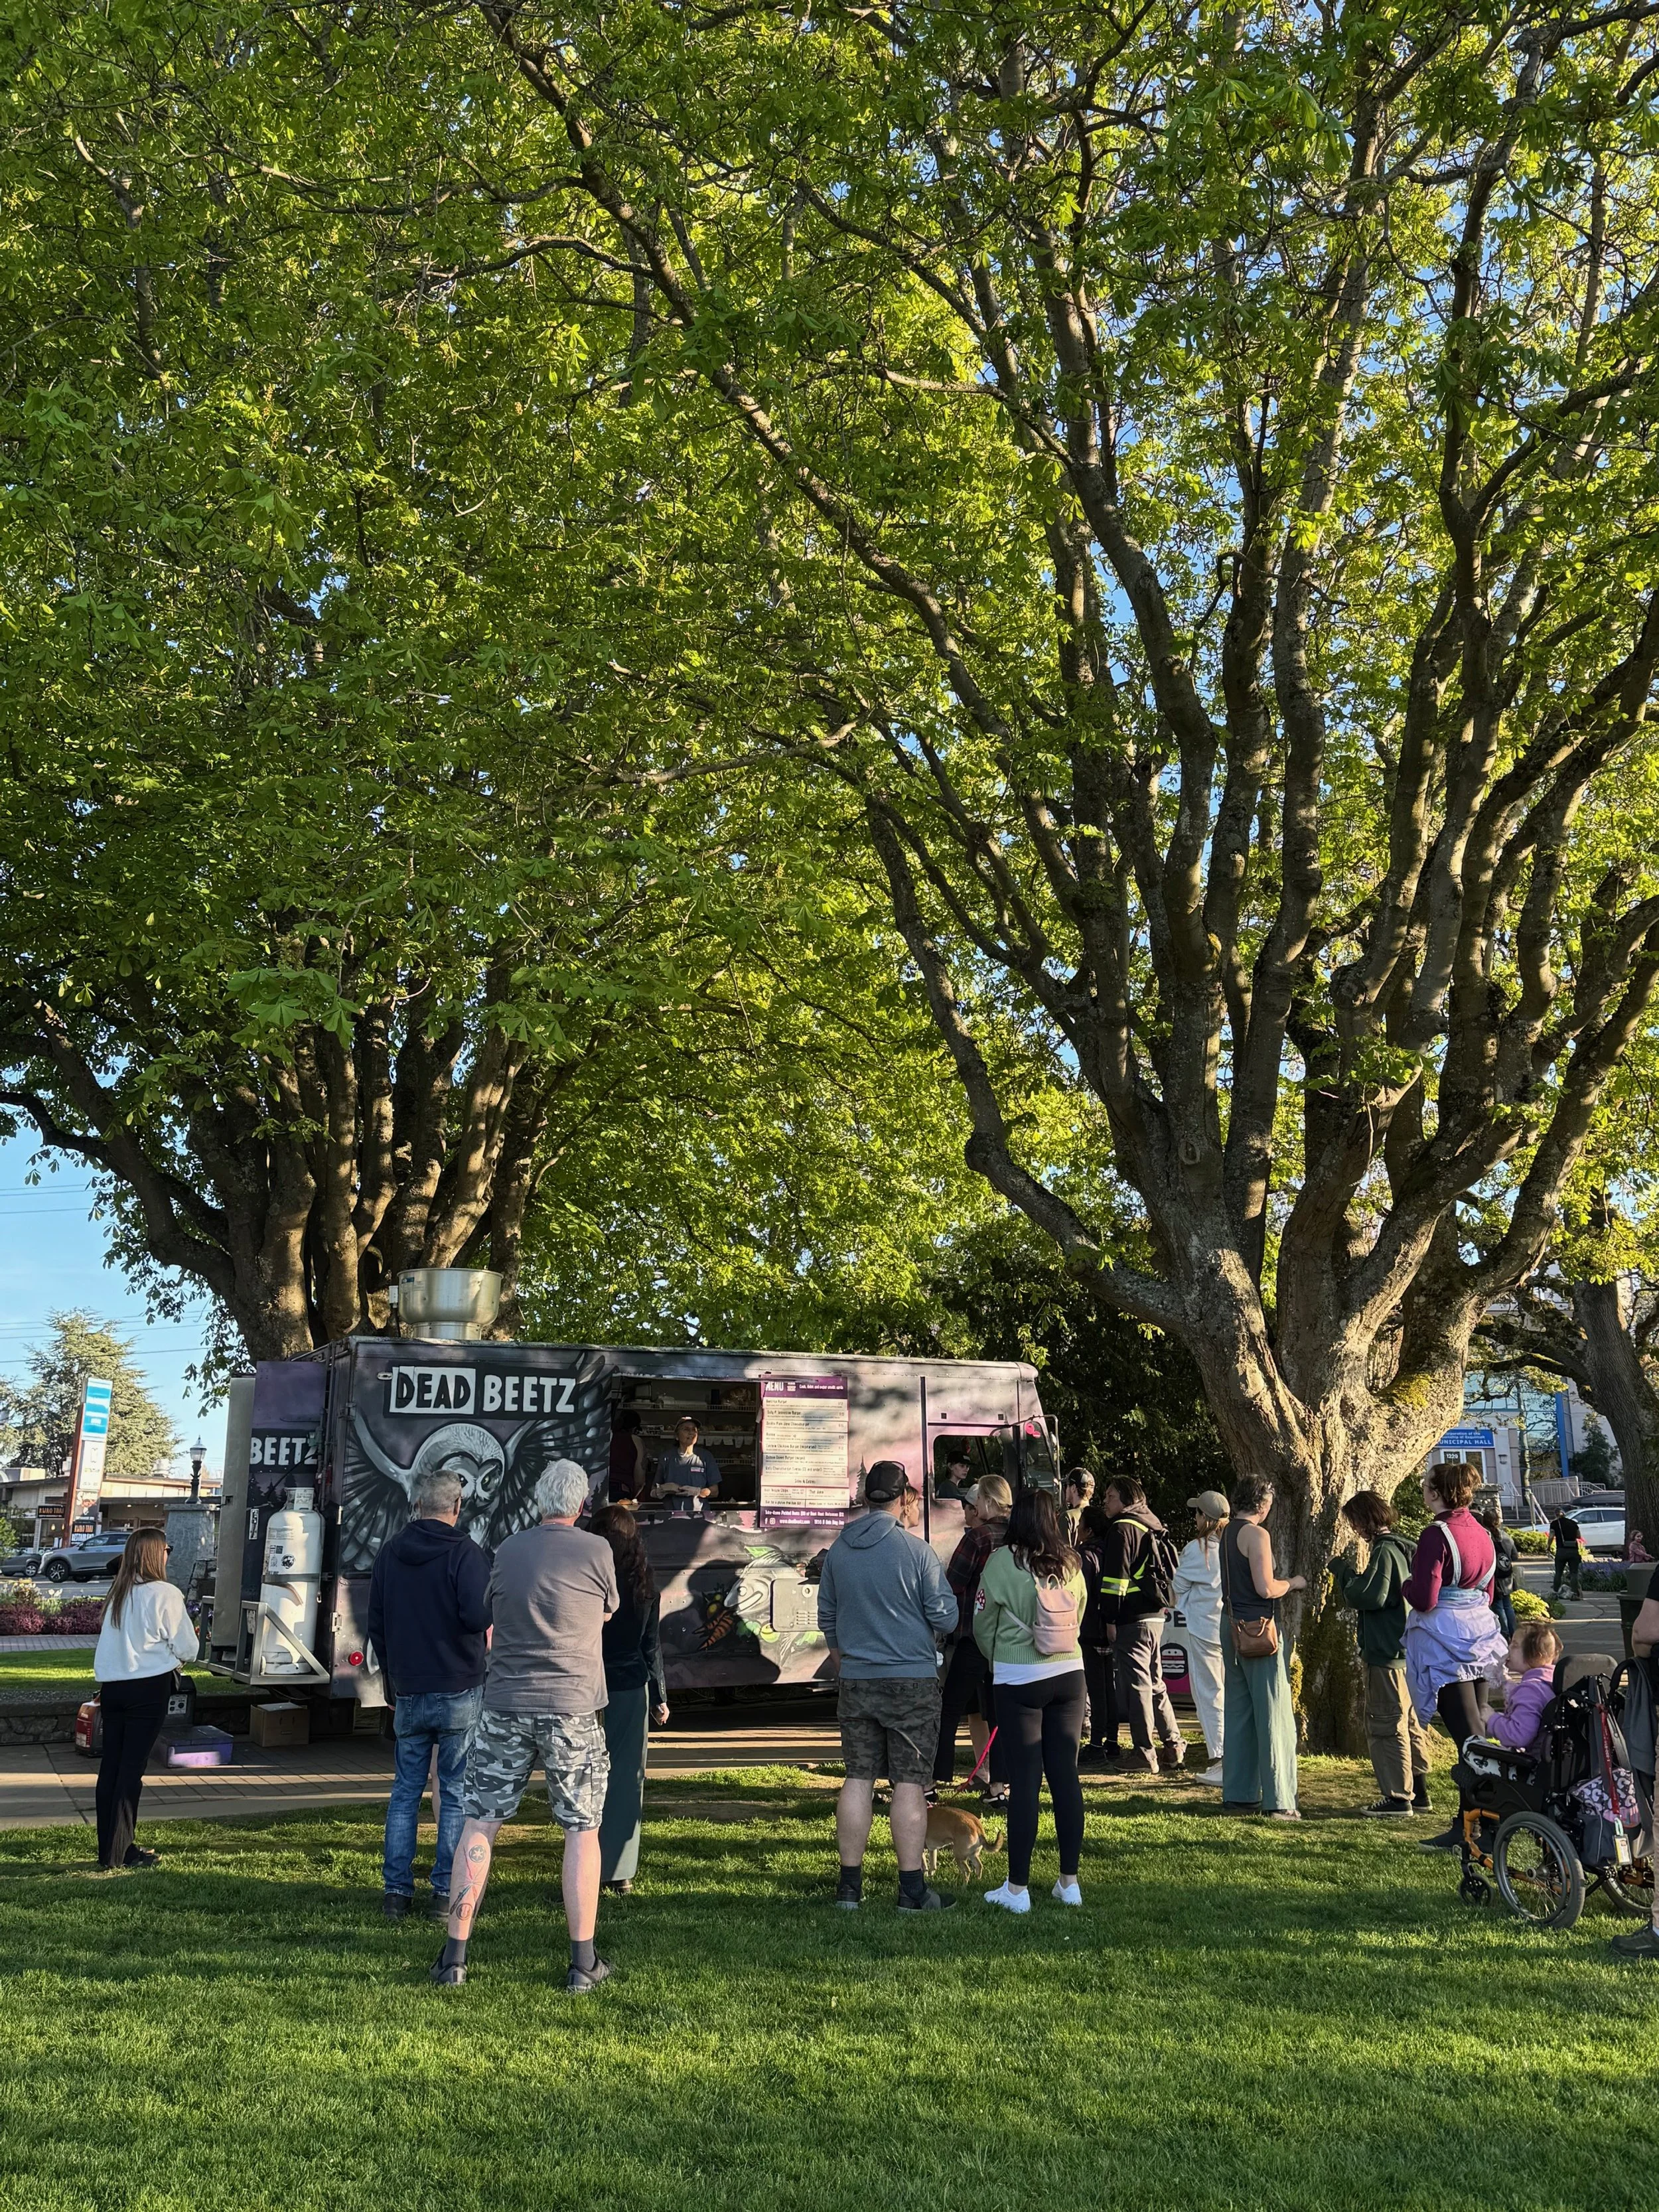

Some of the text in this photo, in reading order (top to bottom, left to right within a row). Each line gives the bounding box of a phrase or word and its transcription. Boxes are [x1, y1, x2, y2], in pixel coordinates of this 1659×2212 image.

[396, 1372, 576, 1413] DEAD BEETZ
[250, 1437, 317, 1465] BEETZ
